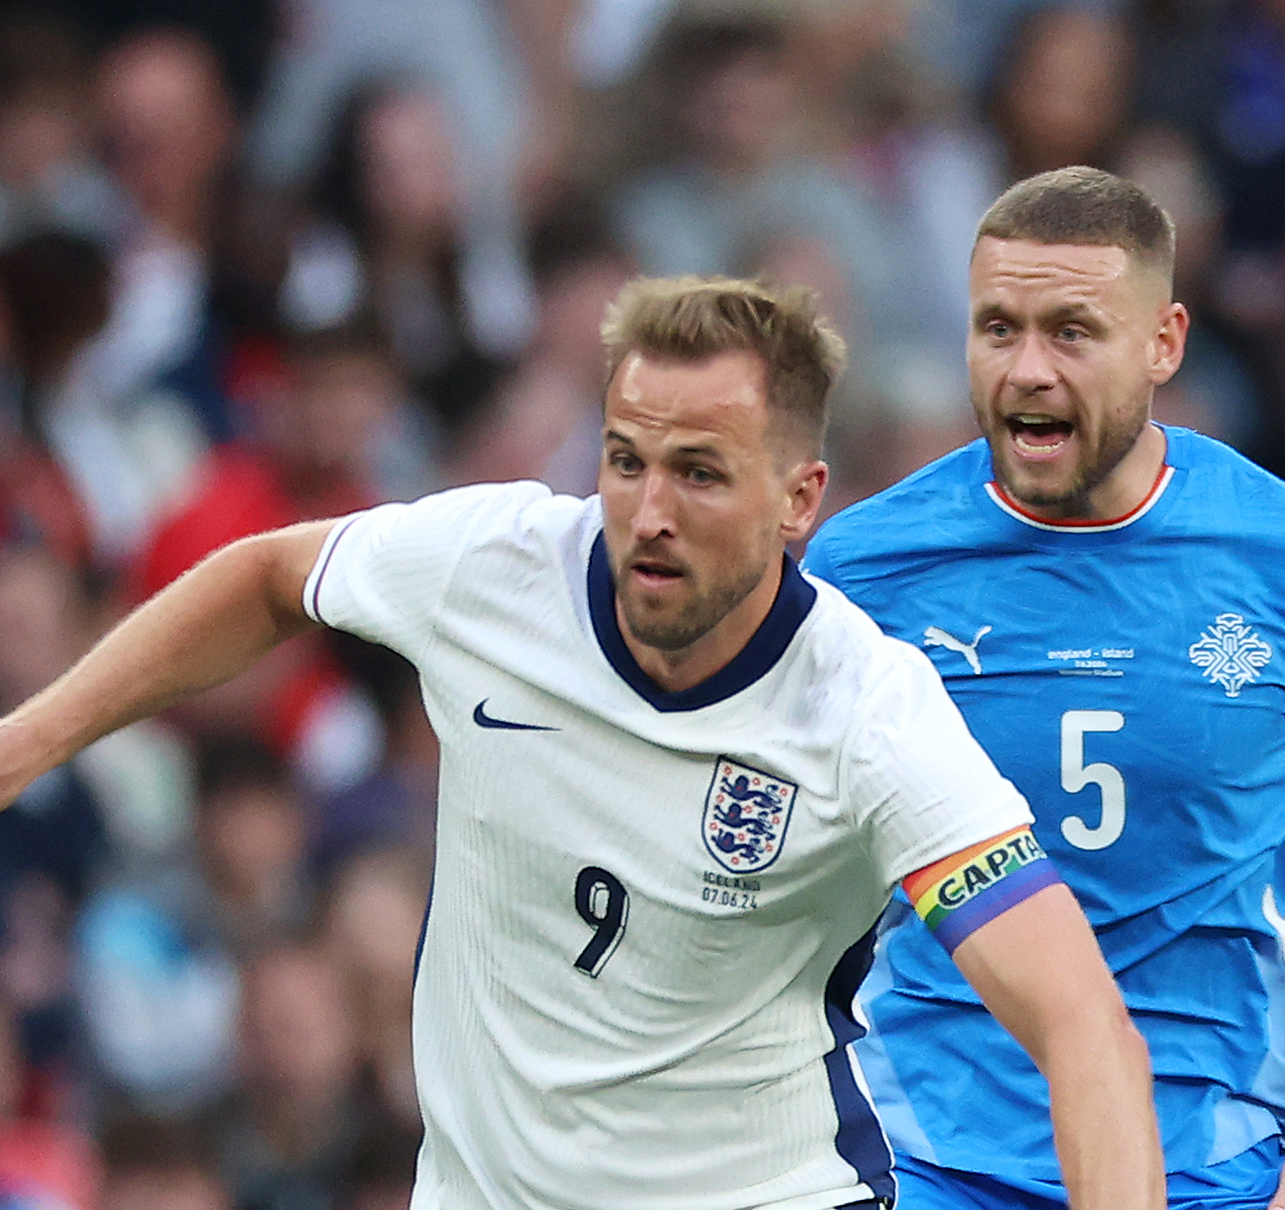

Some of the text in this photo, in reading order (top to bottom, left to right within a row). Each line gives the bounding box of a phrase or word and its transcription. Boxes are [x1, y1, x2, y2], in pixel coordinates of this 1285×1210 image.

[1061, 710, 1126, 851] 5
[573, 866, 630, 979] 9
[702, 886, 757, 909] 07.06.24
